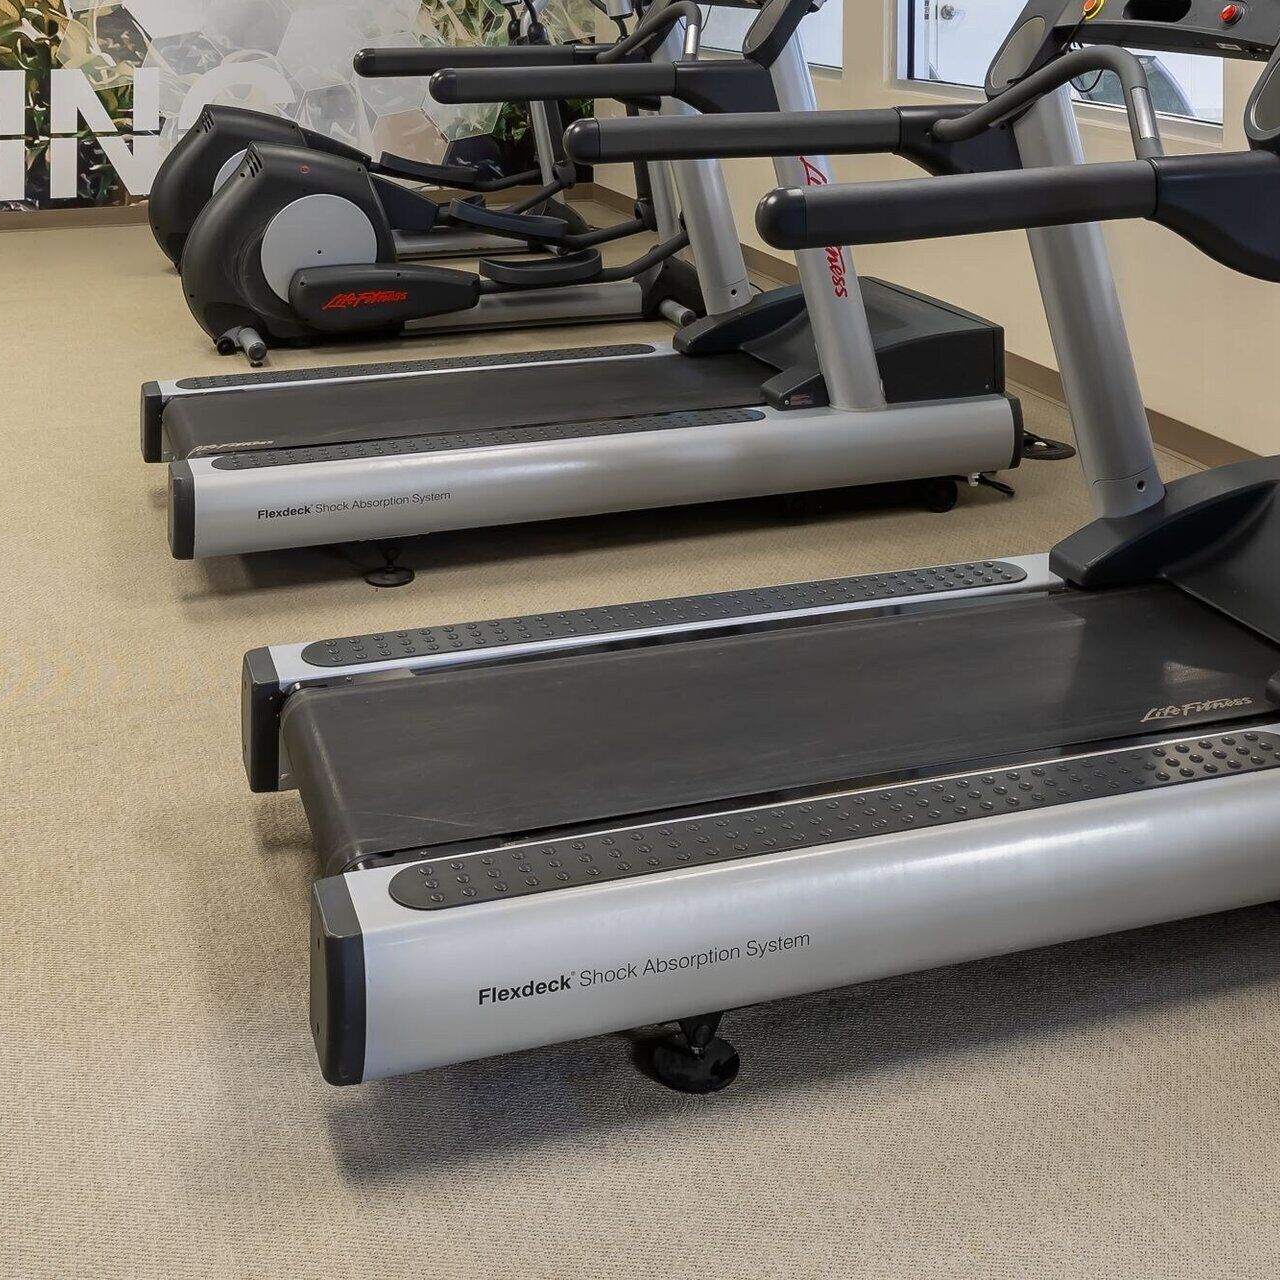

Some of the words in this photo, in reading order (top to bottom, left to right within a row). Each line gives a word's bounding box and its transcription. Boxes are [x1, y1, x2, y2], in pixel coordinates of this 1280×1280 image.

[800, 156, 827, 185] Li
[825, 246, 848, 298] ness
[315, 500, 349, 513] Shock
[352, 495, 410, 510] Absorption
[412, 491, 451, 505] System
[579, 963, 638, 988] Shock
[641, 944, 741, 976] Absorption
[745, 933, 811, 959] System
